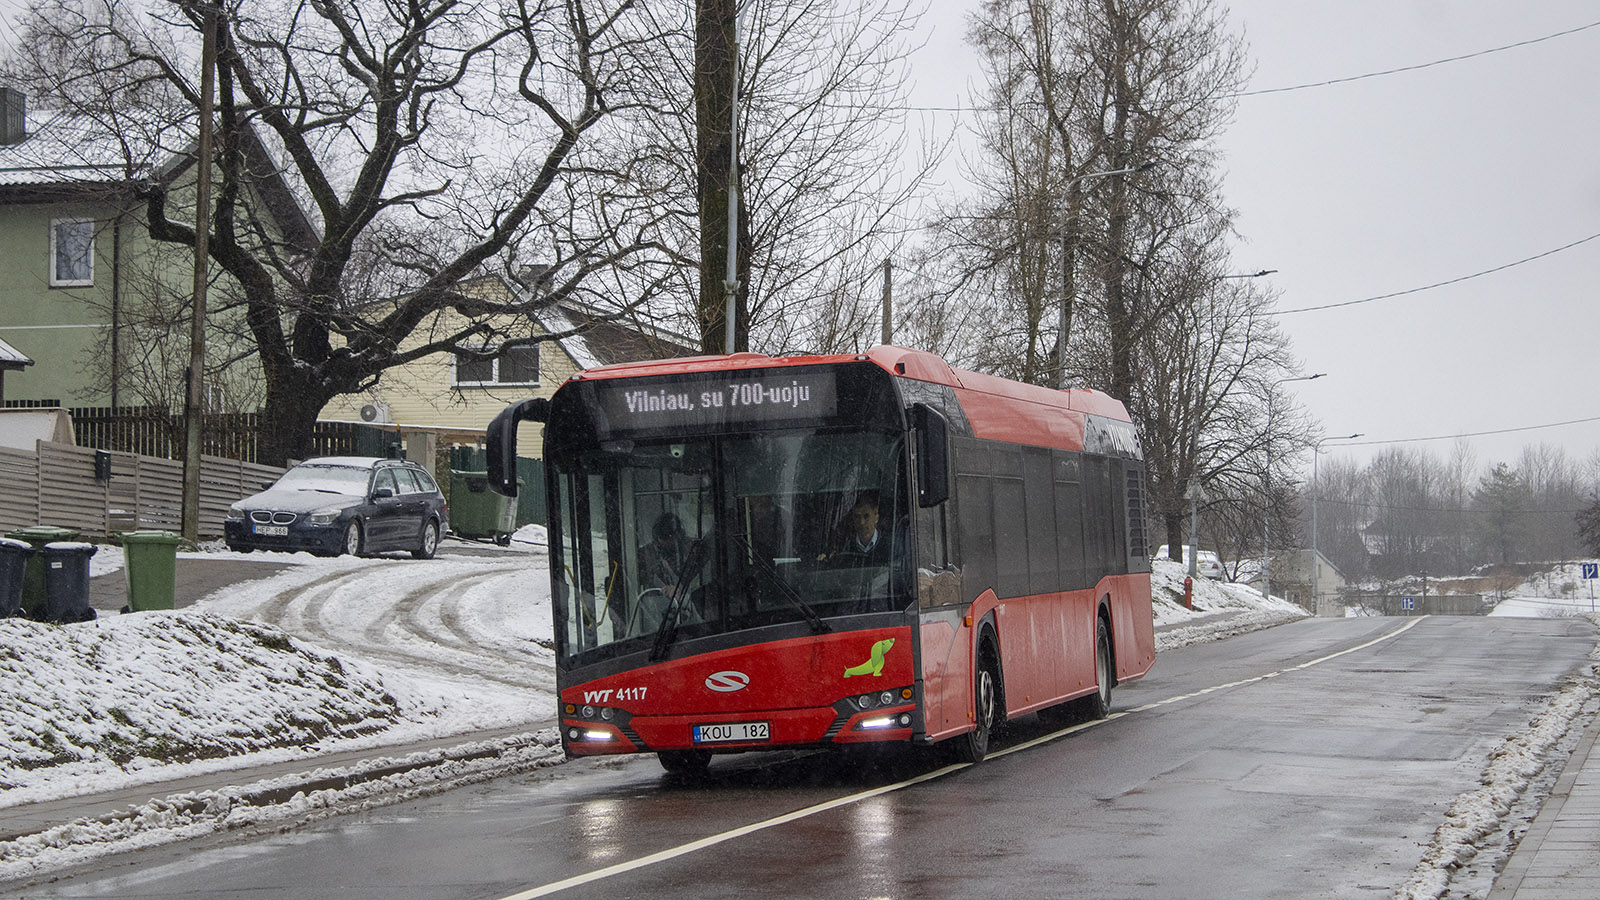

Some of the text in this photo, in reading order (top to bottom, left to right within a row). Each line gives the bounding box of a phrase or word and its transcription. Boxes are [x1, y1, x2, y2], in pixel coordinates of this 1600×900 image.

[625, 381, 810, 412] Vilniau, su 700-uoju
[616, 687, 648, 701] 4117
[701, 724, 767, 739] KOU 182
